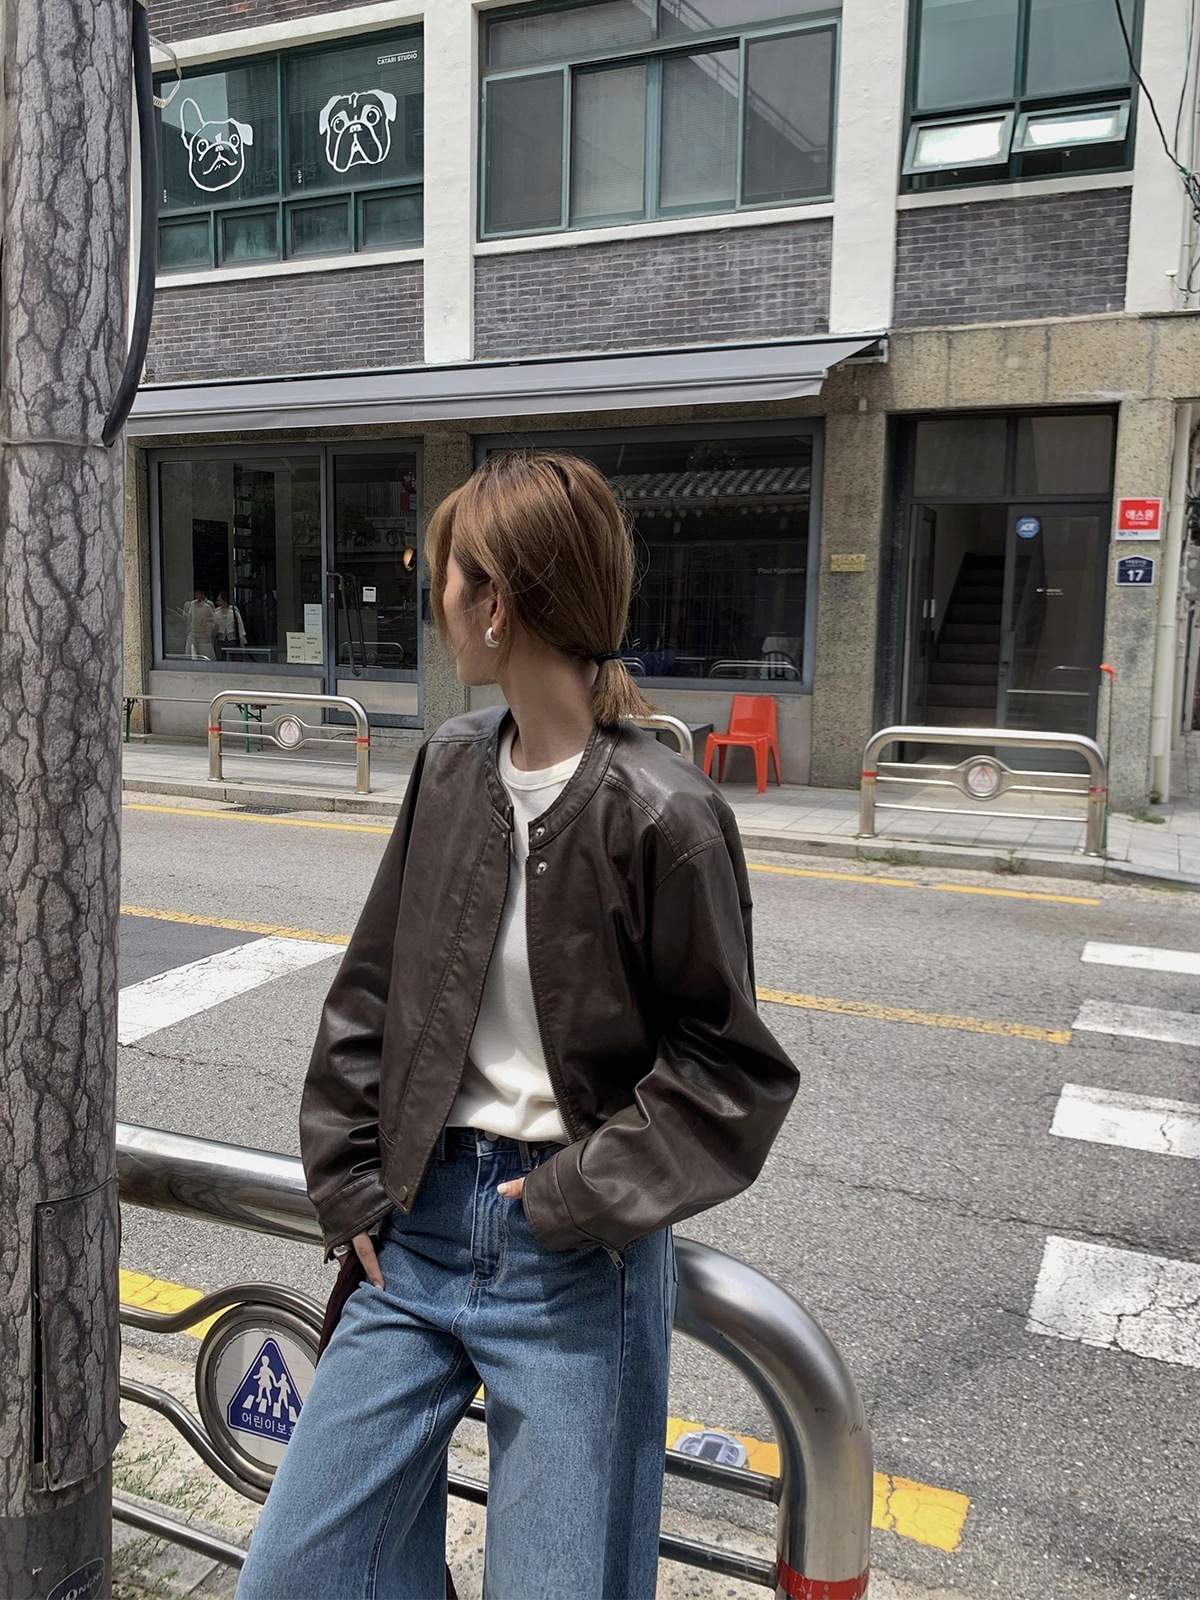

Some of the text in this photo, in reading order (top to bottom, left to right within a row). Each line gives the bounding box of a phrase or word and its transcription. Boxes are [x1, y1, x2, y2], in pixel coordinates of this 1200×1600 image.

[377, 53, 418, 66] CATARI STUDIO
[1127, 569, 1144, 582] 17
